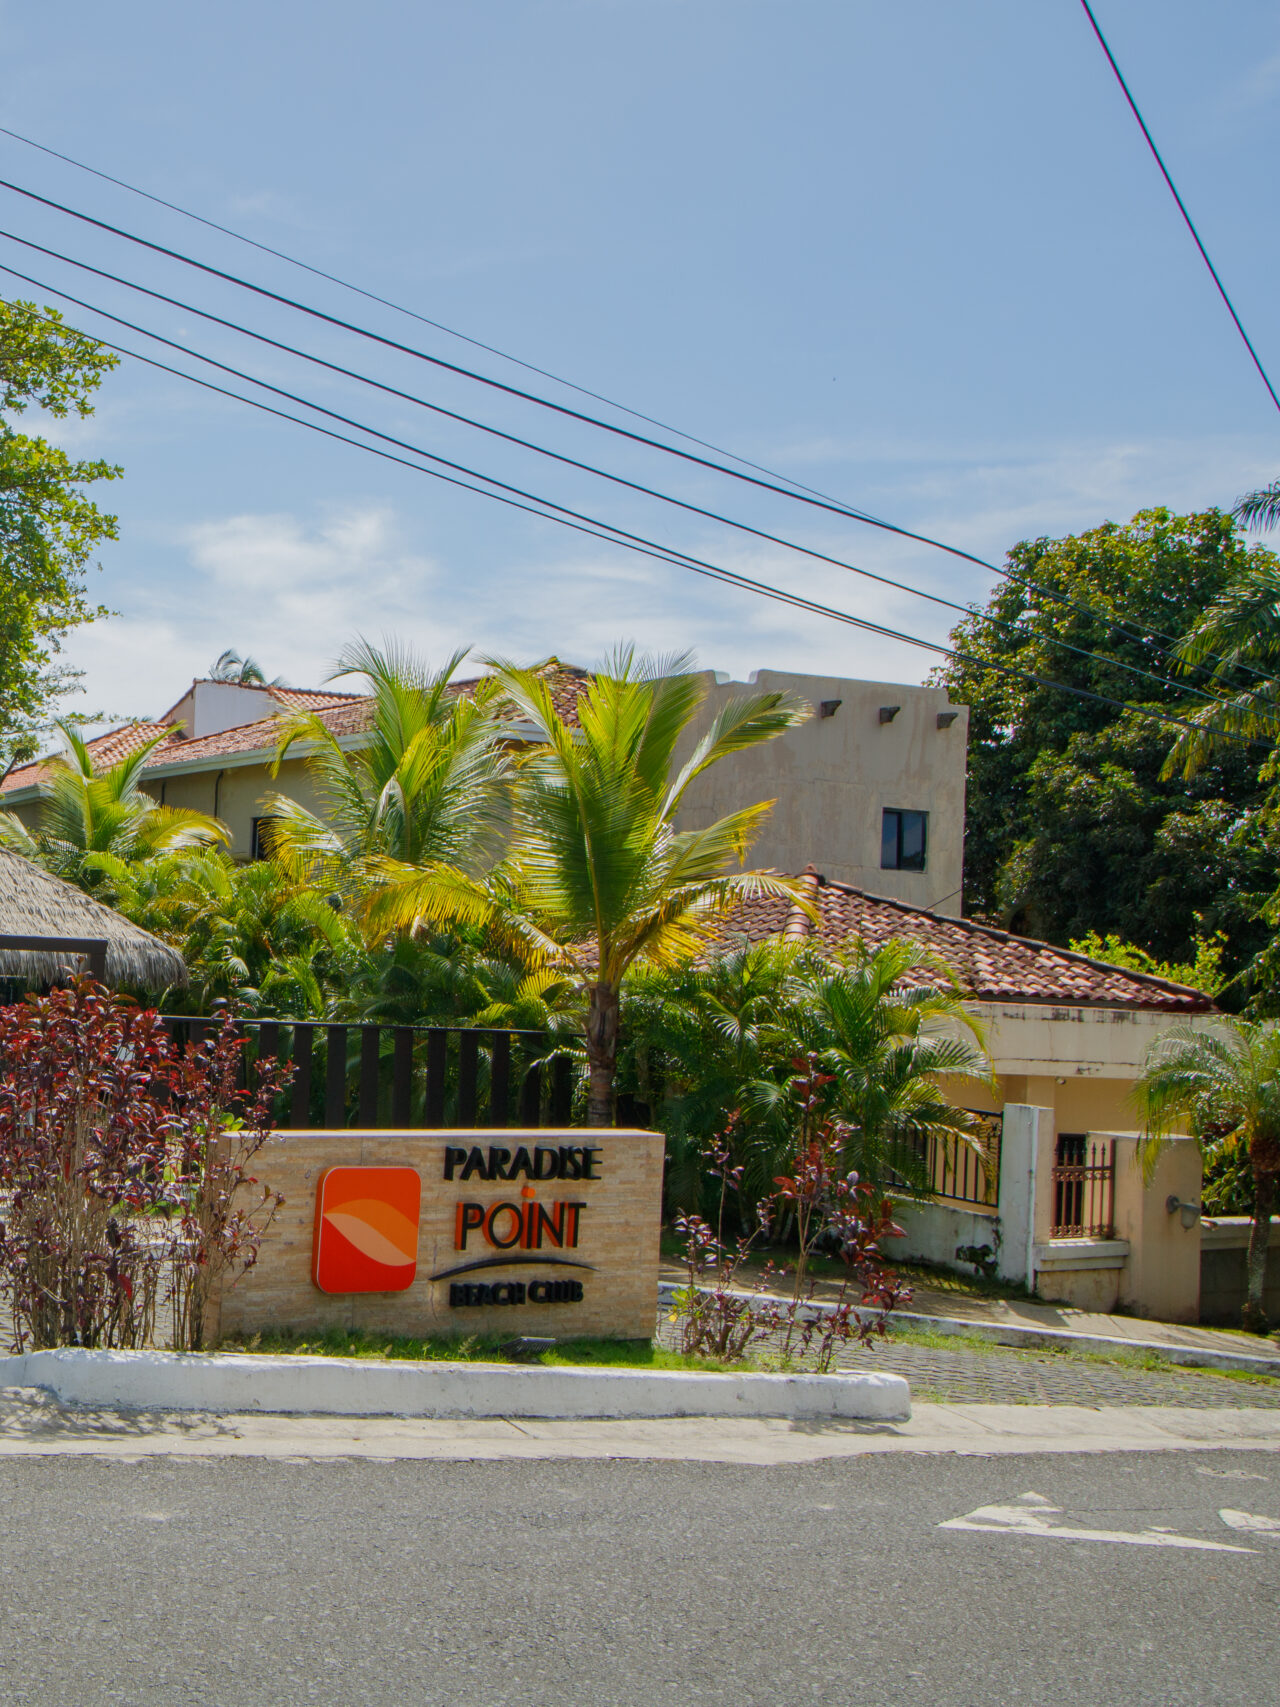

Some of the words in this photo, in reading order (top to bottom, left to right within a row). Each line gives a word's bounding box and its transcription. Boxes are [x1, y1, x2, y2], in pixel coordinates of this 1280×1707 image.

[443, 1145, 603, 1180] PARADISE
[450, 1282, 525, 1307] BEACH
[529, 1280, 583, 1303] CLUB
